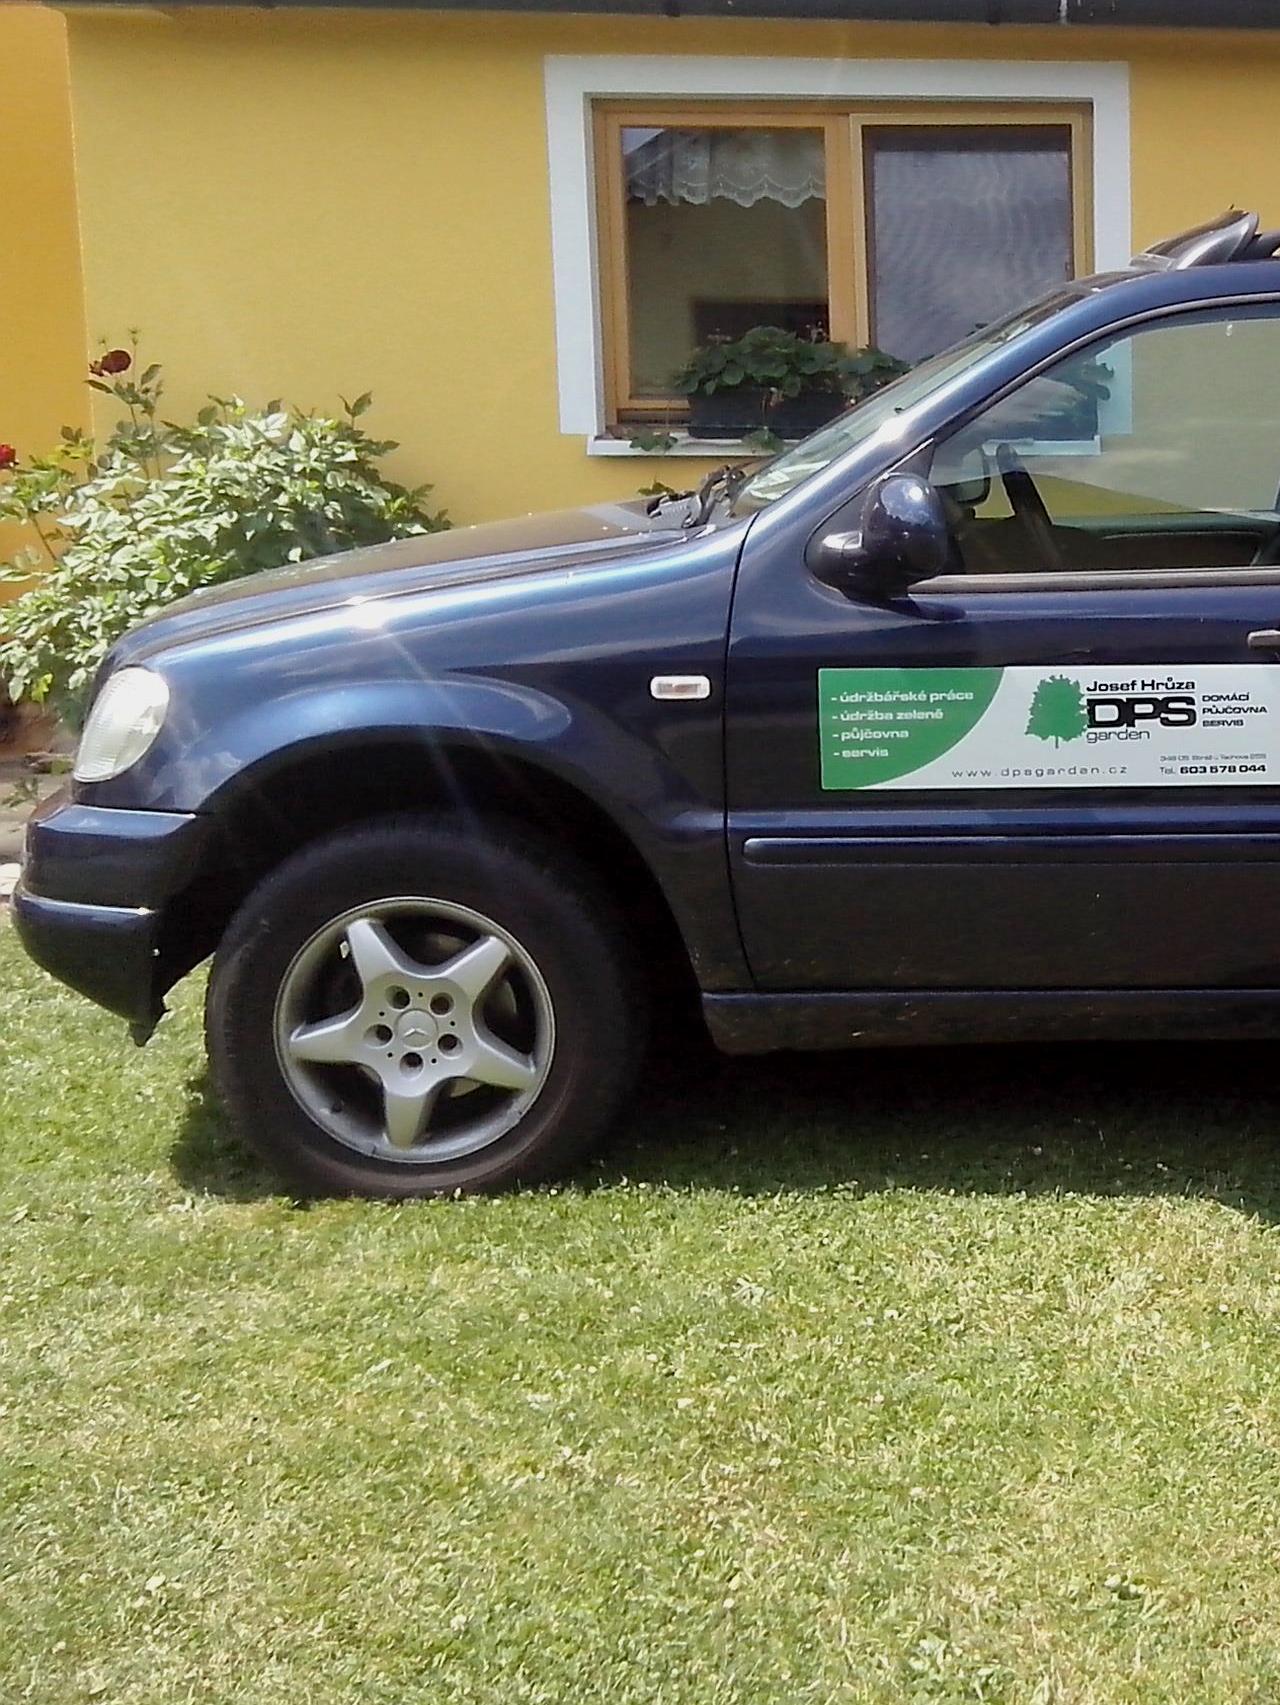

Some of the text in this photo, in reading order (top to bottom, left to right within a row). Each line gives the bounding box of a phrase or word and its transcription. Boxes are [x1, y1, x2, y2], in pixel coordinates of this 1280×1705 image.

[1086, 677, 1196, 692] Josef Hrůza
[930, 688, 974, 703] práce
[1202, 692, 1249, 702] DOMÁCÍ
[840, 709, 893, 721] údržba
[896, 708, 944, 720] zelené
[1087, 696, 1196, 728] DPS
[1202, 719, 1244, 727] SERVIS
[841, 727, 909, 741] půjčovna
[1086, 728, 1150, 744] garden
[842, 748, 889, 758] servis
[952, 766, 1128, 779] www.dpsgarden.cz
[1180, 765, 1207, 774] 603
[1239, 764, 1266, 773] 044
